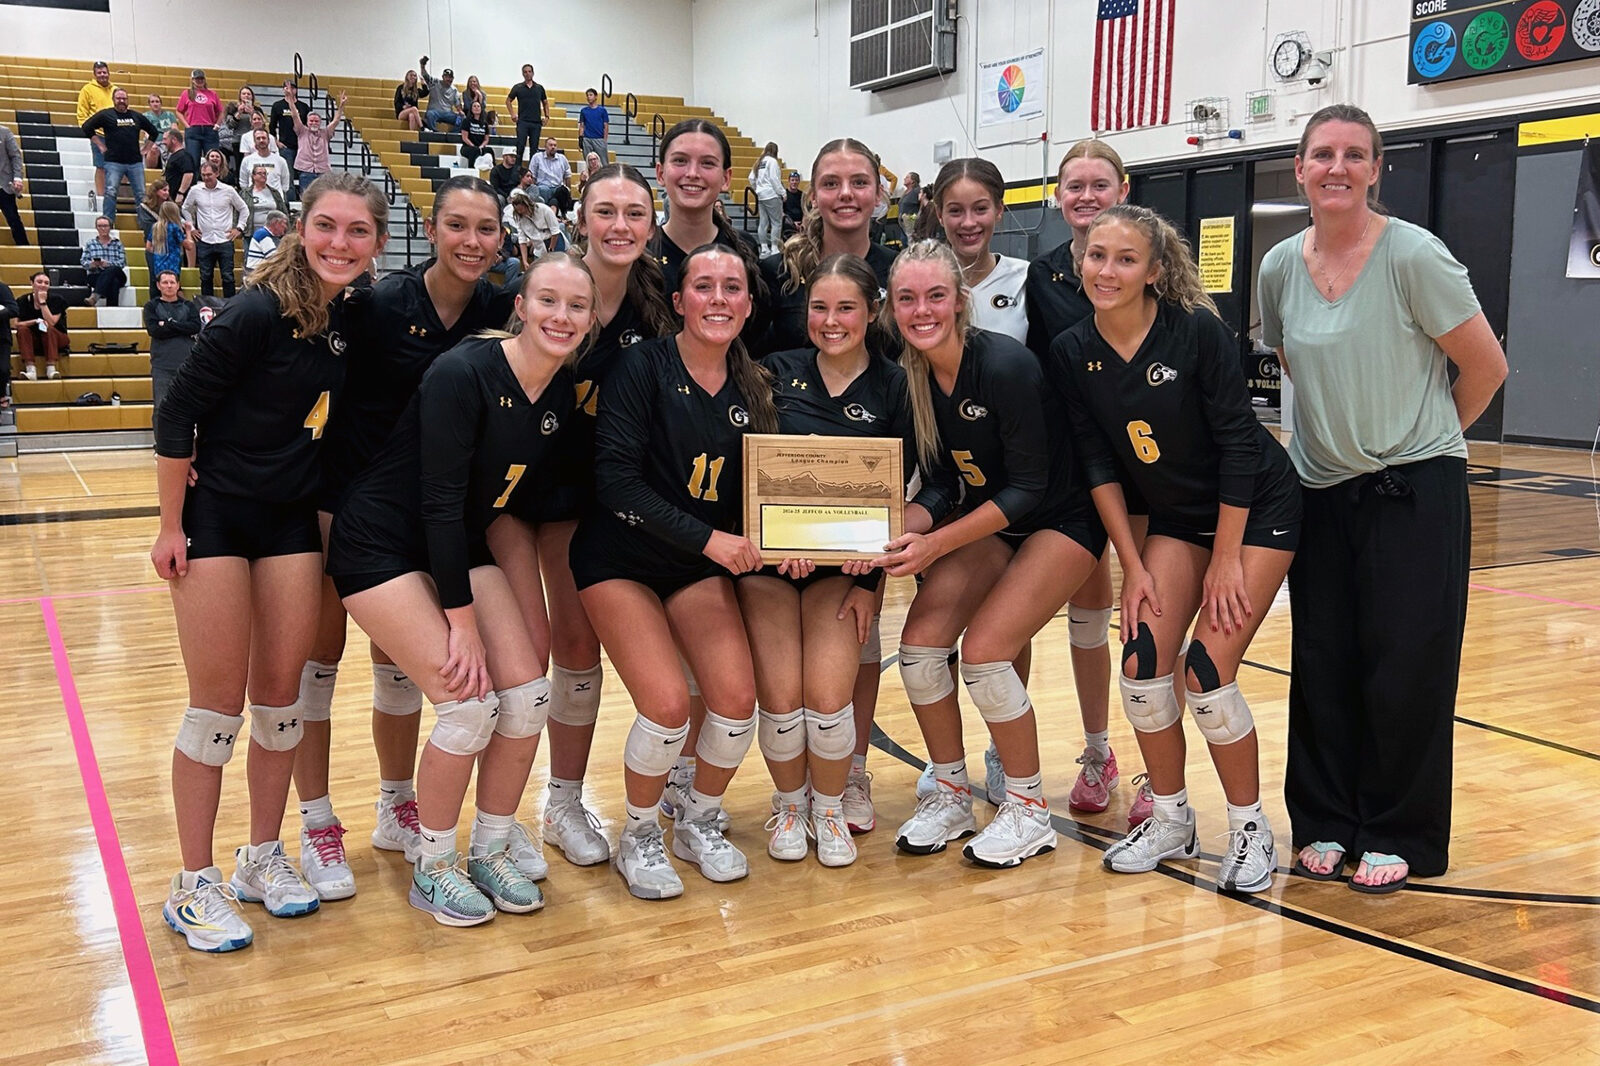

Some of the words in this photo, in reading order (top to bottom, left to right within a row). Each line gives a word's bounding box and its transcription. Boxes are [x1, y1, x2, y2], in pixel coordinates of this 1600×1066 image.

[1415, 0, 1447, 16] SCORE
[303, 390, 330, 440] 4
[1126, 420, 1161, 464] 6
[492, 464, 527, 508] 7
[687, 452, 725, 502] 11
[951, 450, 987, 487] 5
